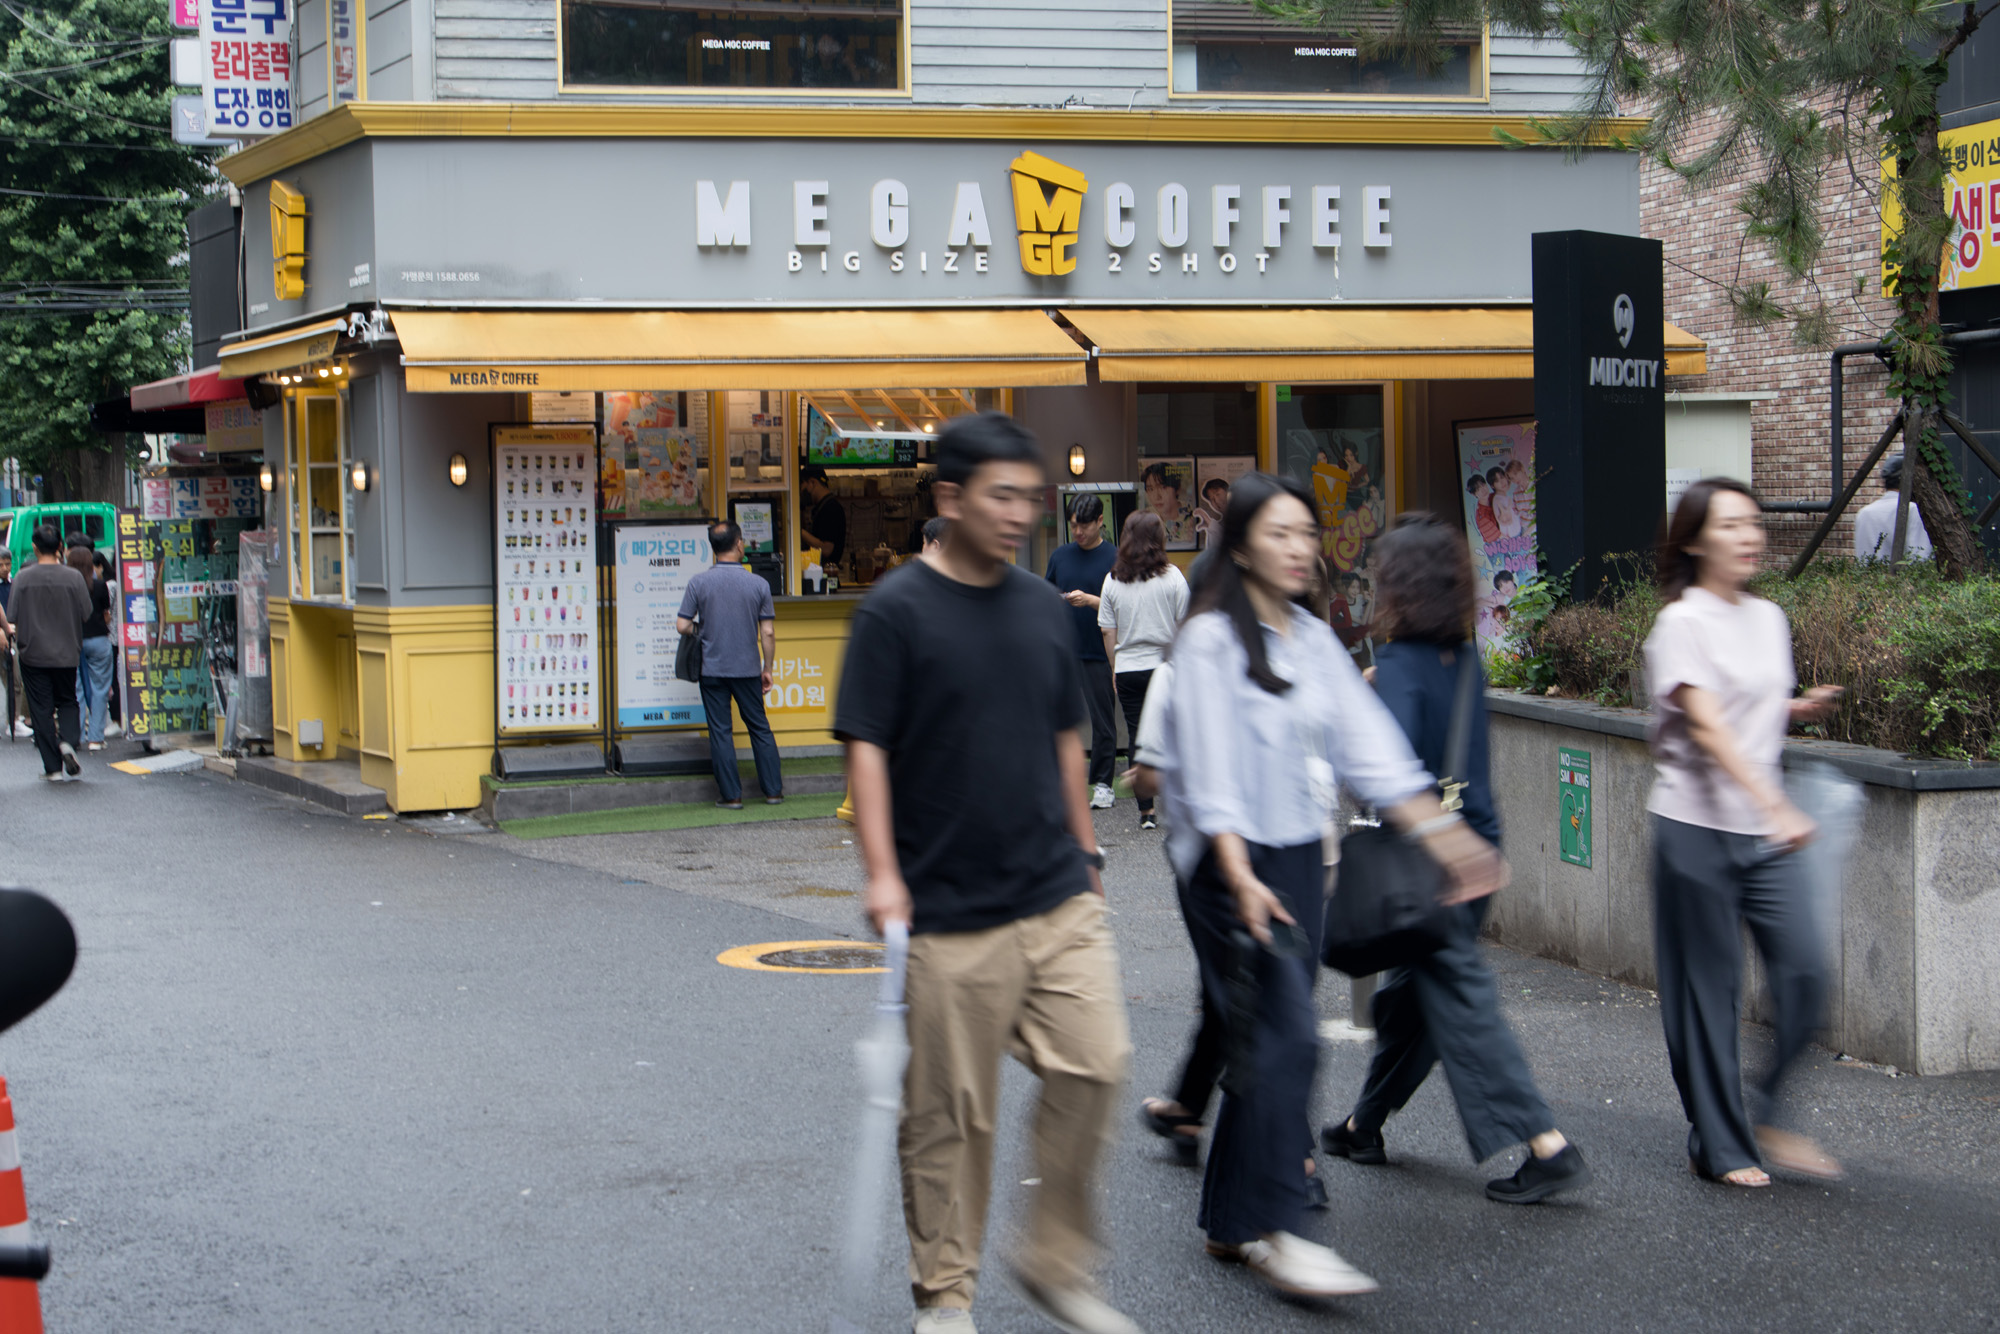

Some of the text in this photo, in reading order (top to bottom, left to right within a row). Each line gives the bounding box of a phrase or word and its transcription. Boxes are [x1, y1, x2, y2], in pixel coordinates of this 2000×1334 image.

[702, 39, 724, 49] MEGA
[742, 40, 771, 51] COFFEE
[1295, 47, 1315, 56] MEGA
[1331, 48, 1357, 57] COFFEE
[211, 41, 290, 81] 칼라출력
[696, 178, 993, 249] MEGA
[1104, 181, 1393, 248] COFFEE
[449, 372, 489, 386] MEGA
[501, 372, 540, 386] COFFEE
[1589, 356, 1660, 388] MIDCITY
[632, 540, 696, 557] 메가오더
[649, 558, 680, 568] 사용방법
[762, 657, 823, 680] 리카노
[643, 711, 692, 721] MEGA COFFEE
[1560, 752, 1570, 767] NO
